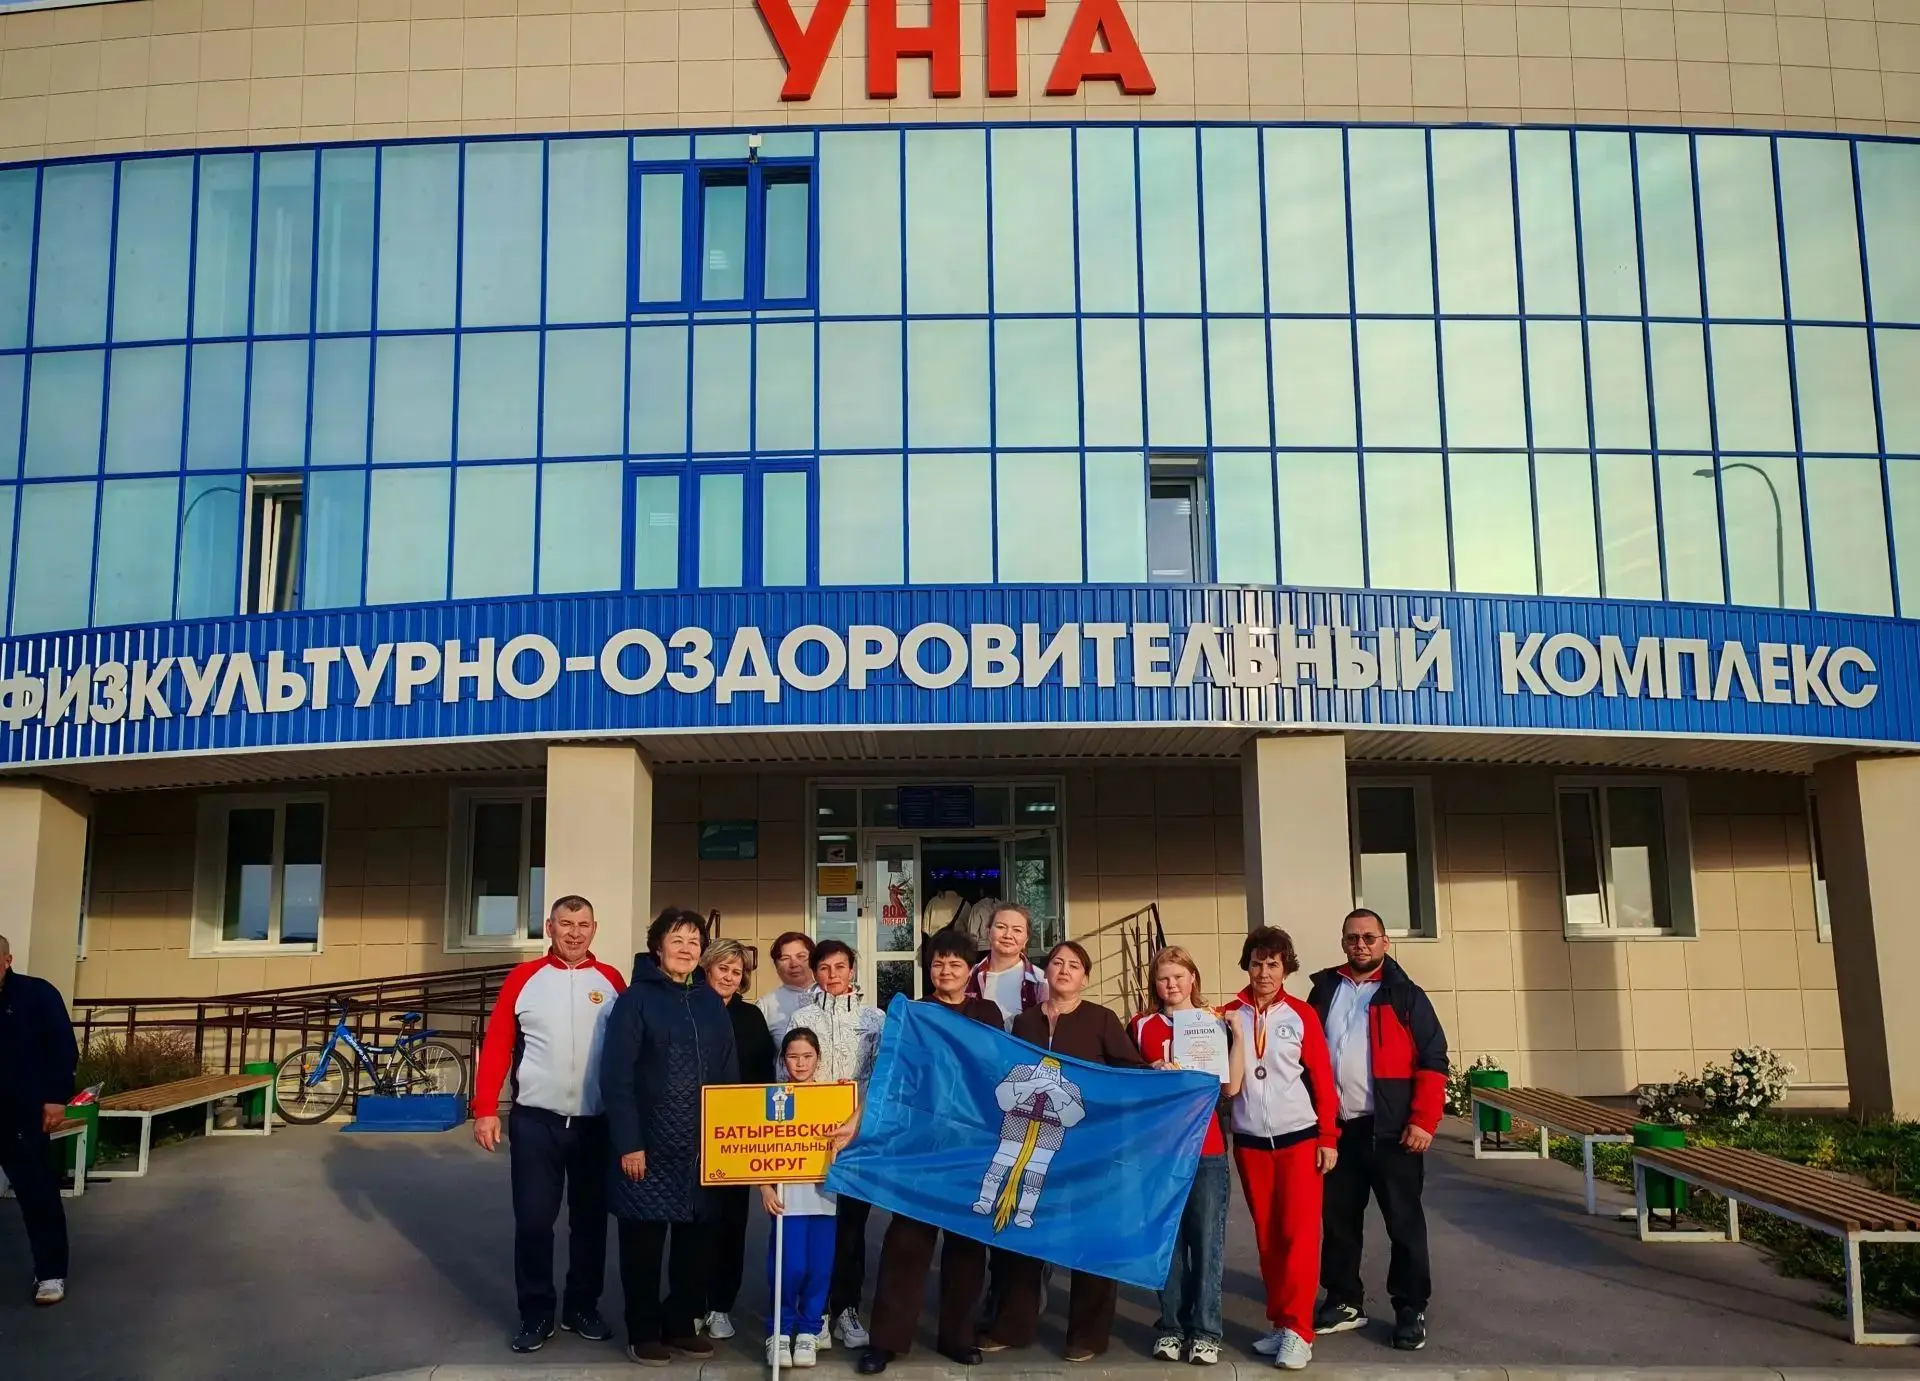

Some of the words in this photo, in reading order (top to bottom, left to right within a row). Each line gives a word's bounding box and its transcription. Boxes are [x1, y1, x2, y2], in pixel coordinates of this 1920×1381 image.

[755, 0, 1157, 101] УНГА
[0, 614, 1455, 730] ФИЗКУЛЬТУРНО-ОЗДОРОВИТЕЛЬНЫЙ
[1501, 630, 1879, 709] КОМПЛЕКС
[1183, 1028, 1215, 1036] ДИПЛОМ
[720, 1142, 834, 1155] МУНИЦИПАЛЬНЫ
[749, 1157, 807, 1172] ОКРУГ
